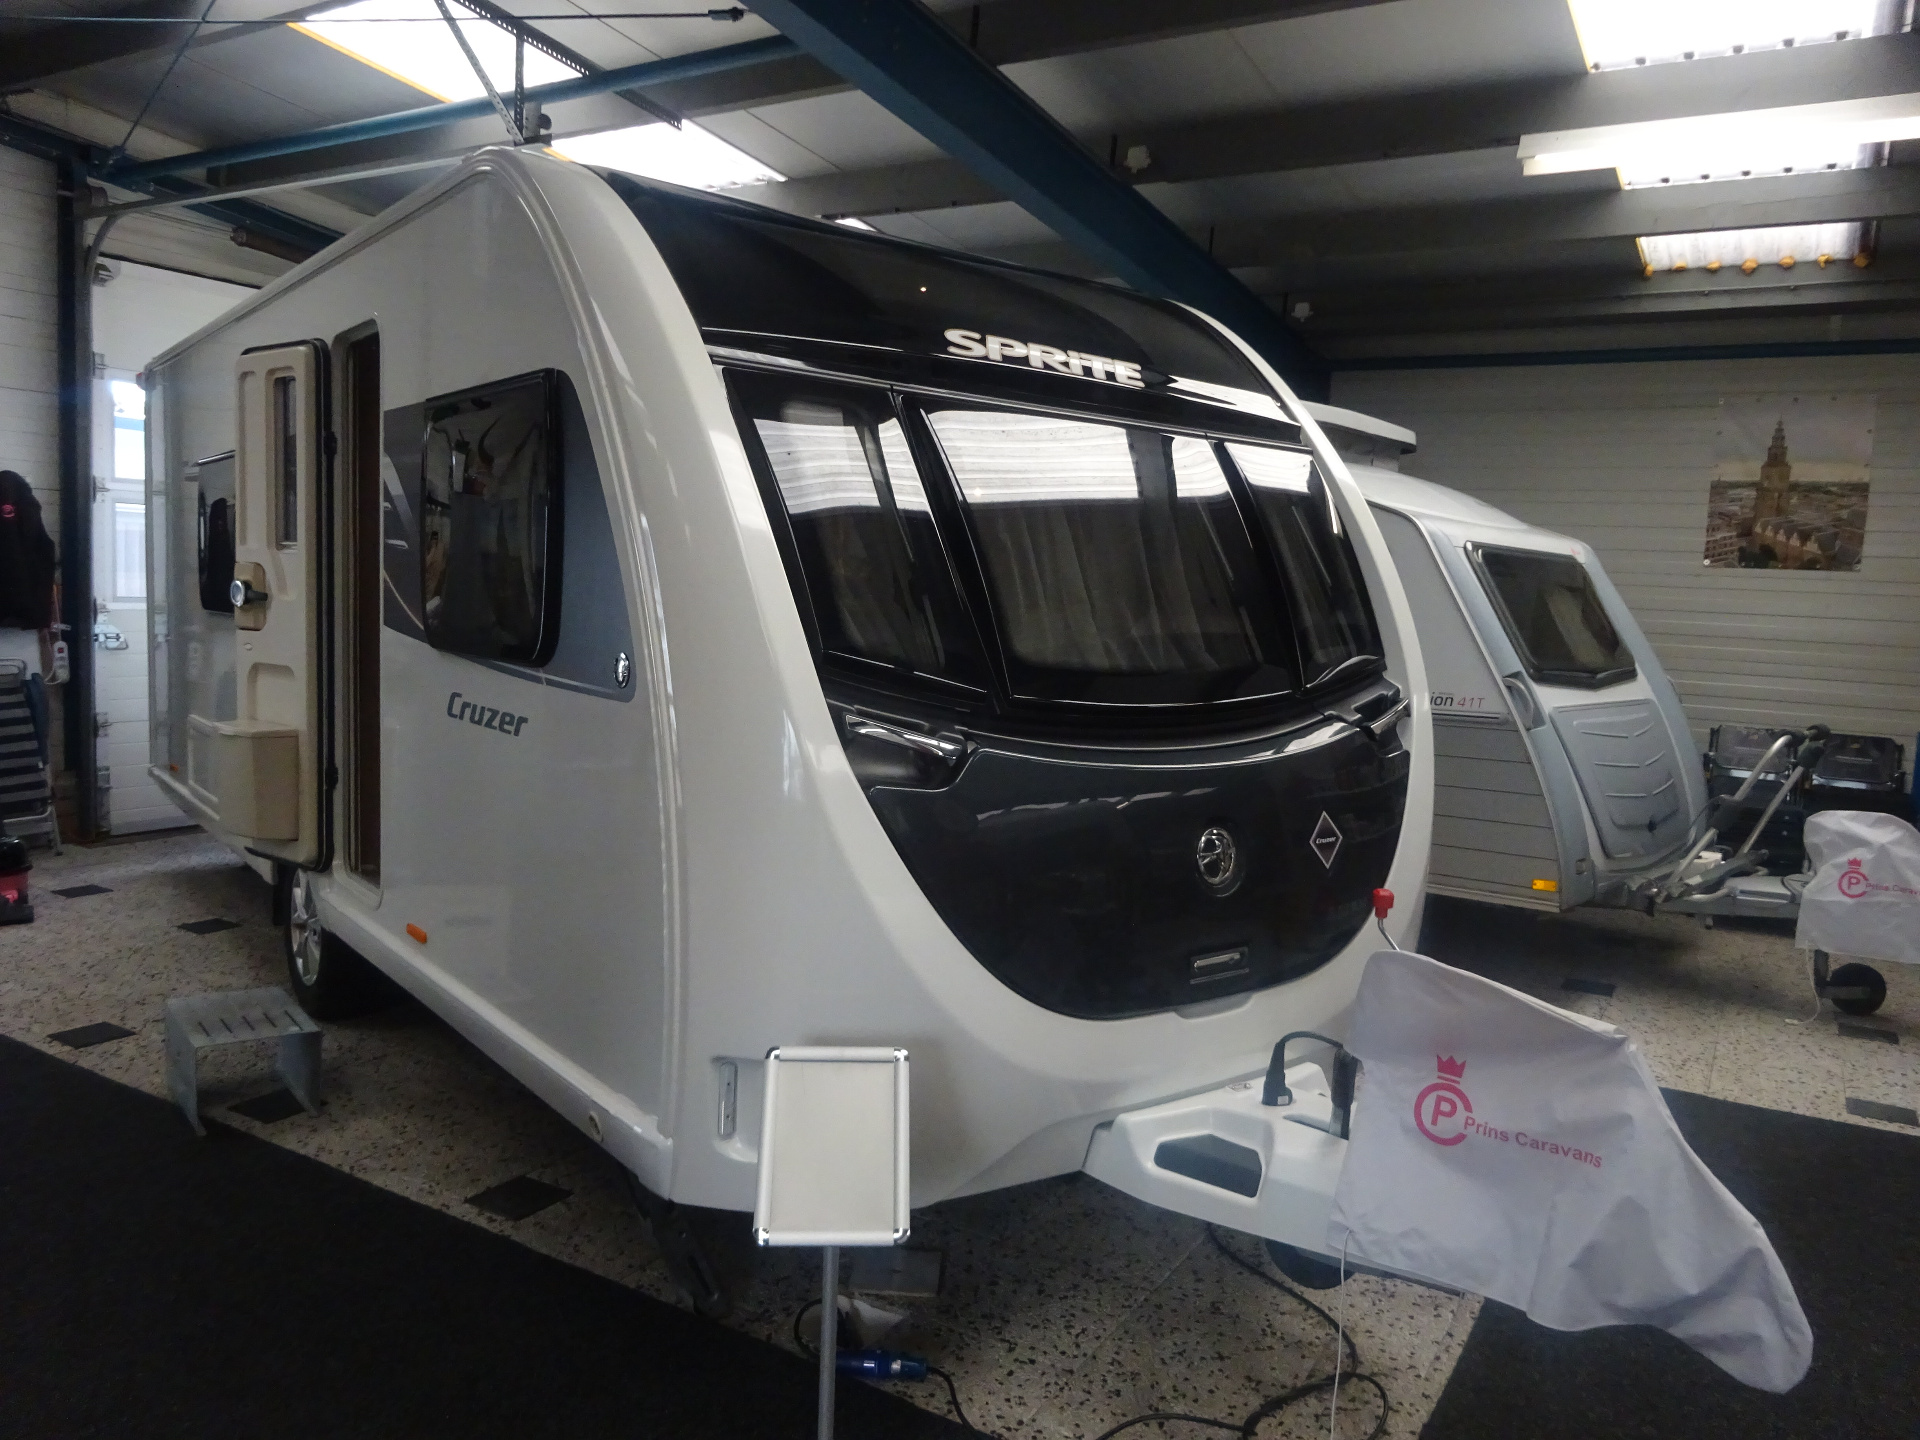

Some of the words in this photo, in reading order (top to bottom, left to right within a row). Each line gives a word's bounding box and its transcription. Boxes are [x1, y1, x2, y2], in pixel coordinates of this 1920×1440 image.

[446, 691, 530, 737] Cruzer
[1457, 697, 1485, 709] 41T
[1316, 836, 1337, 844] Cruzer
[1463, 1115, 1509, 1142] Prins
[1515, 1131, 1604, 1169] Caravans
